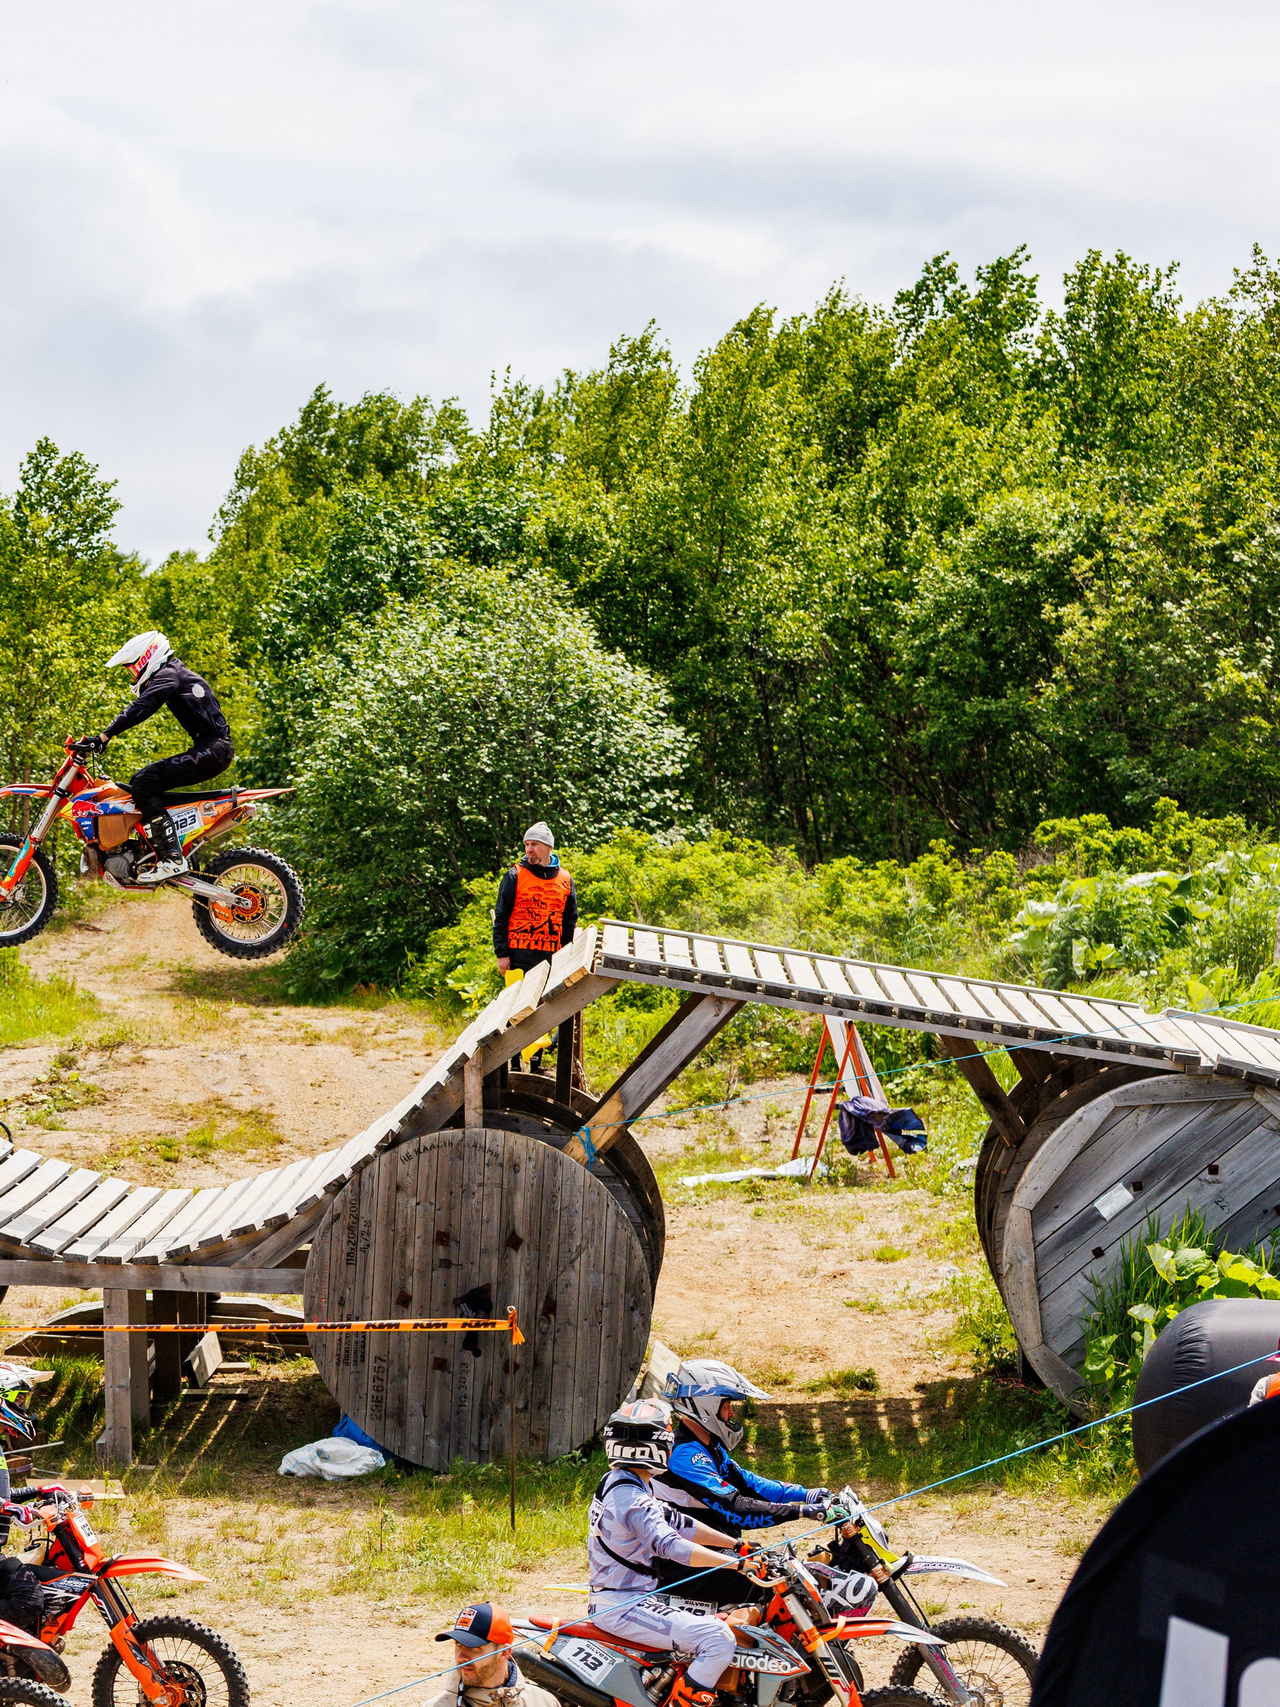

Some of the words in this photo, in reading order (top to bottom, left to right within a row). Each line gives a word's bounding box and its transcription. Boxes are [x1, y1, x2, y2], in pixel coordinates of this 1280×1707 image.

[684, 1600, 711, 1608] SILVER
[572, 1647, 604, 1671] 113
[586, 1643, 609, 1661] SILVER
